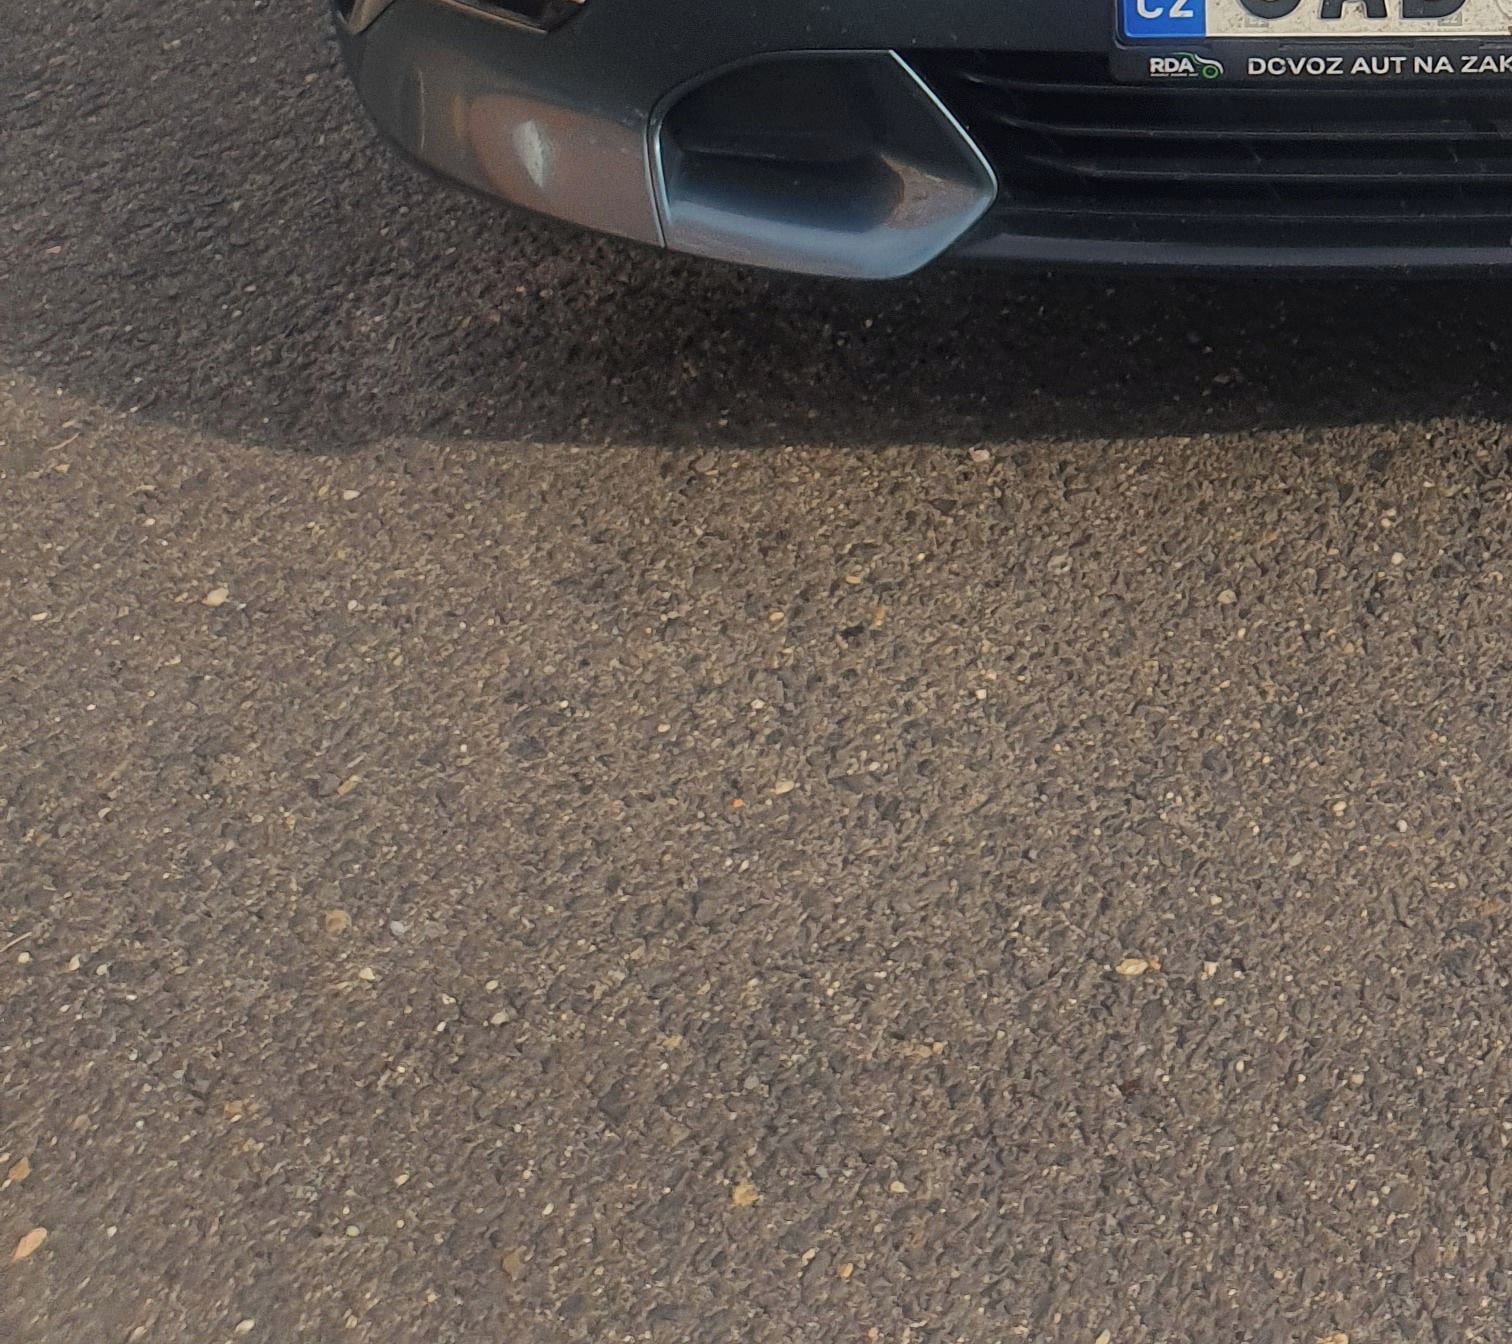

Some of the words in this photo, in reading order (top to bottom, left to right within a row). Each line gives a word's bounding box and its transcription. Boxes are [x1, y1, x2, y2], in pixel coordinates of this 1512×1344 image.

[1149, 57, 1195, 73] RDA
[1350, 56, 1407, 74] AUT
[1413, 55, 1455, 73] NA
